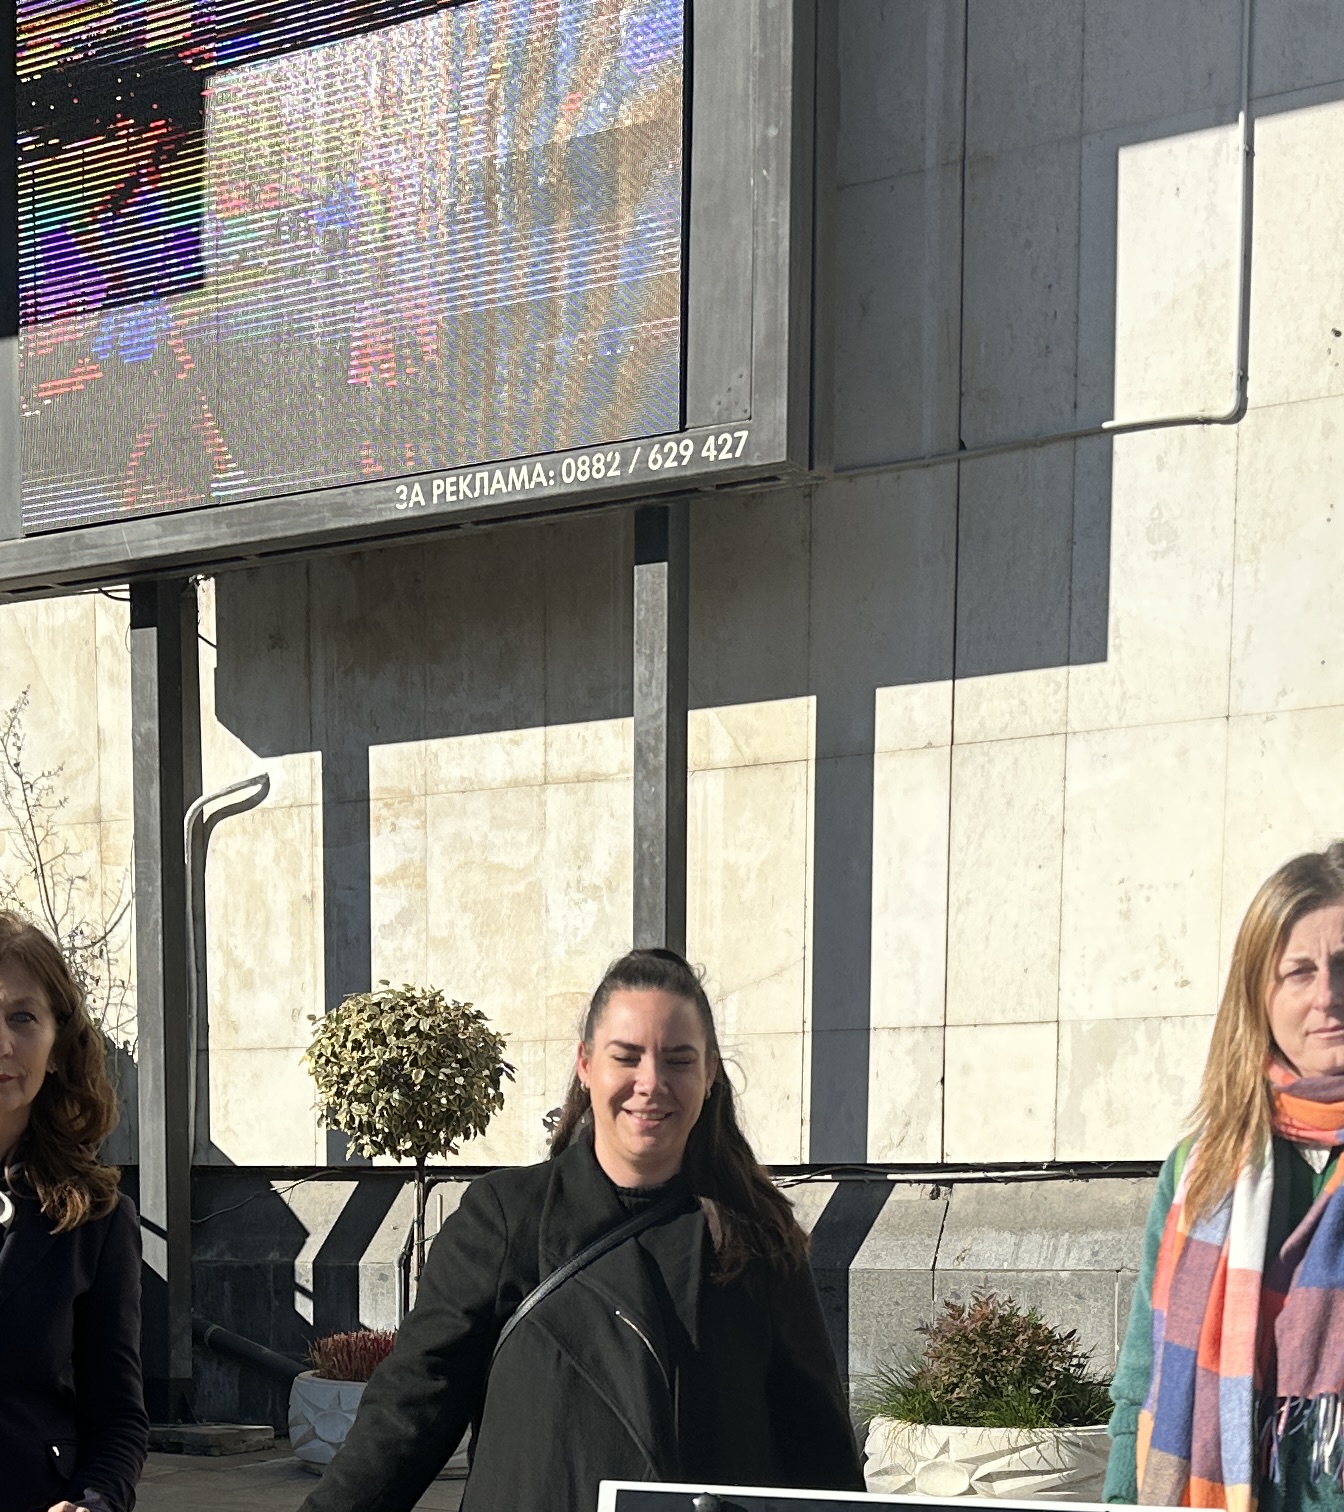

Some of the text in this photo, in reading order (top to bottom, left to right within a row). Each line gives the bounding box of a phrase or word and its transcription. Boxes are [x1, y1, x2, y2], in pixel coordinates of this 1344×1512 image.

[395, 430, 750, 510] ЗА РЕКЛАМА: 0882 / 629 427
